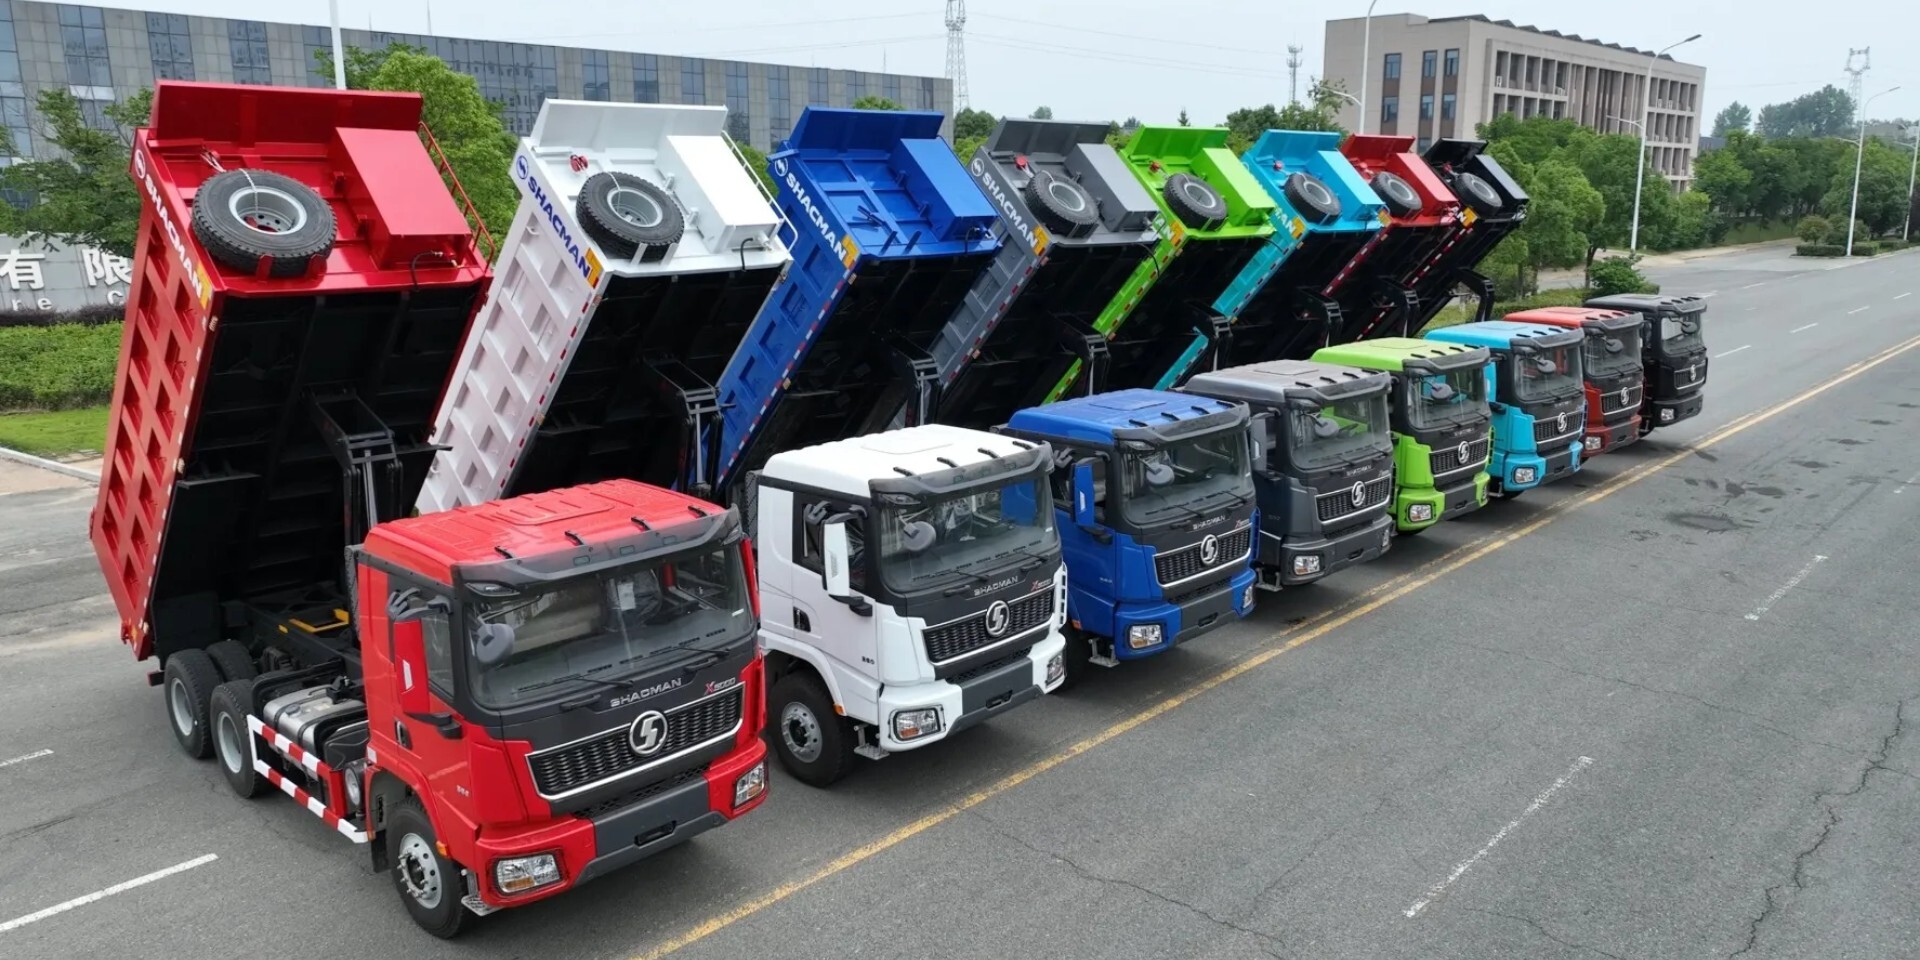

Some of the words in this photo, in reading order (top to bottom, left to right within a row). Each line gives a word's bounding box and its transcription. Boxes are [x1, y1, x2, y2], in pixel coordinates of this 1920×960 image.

[145, 173, 203, 299] SHACMAN
[527, 176, 591, 278] SHACMAN
[786, 172, 847, 262] SHACMAN
[982, 172, 1039, 248] SHACMAN
[1192, 515, 1226, 531] SHACMAN
[973, 575, 1019, 597] SHACMAN
[610, 677, 683, 708] SHACMAN
